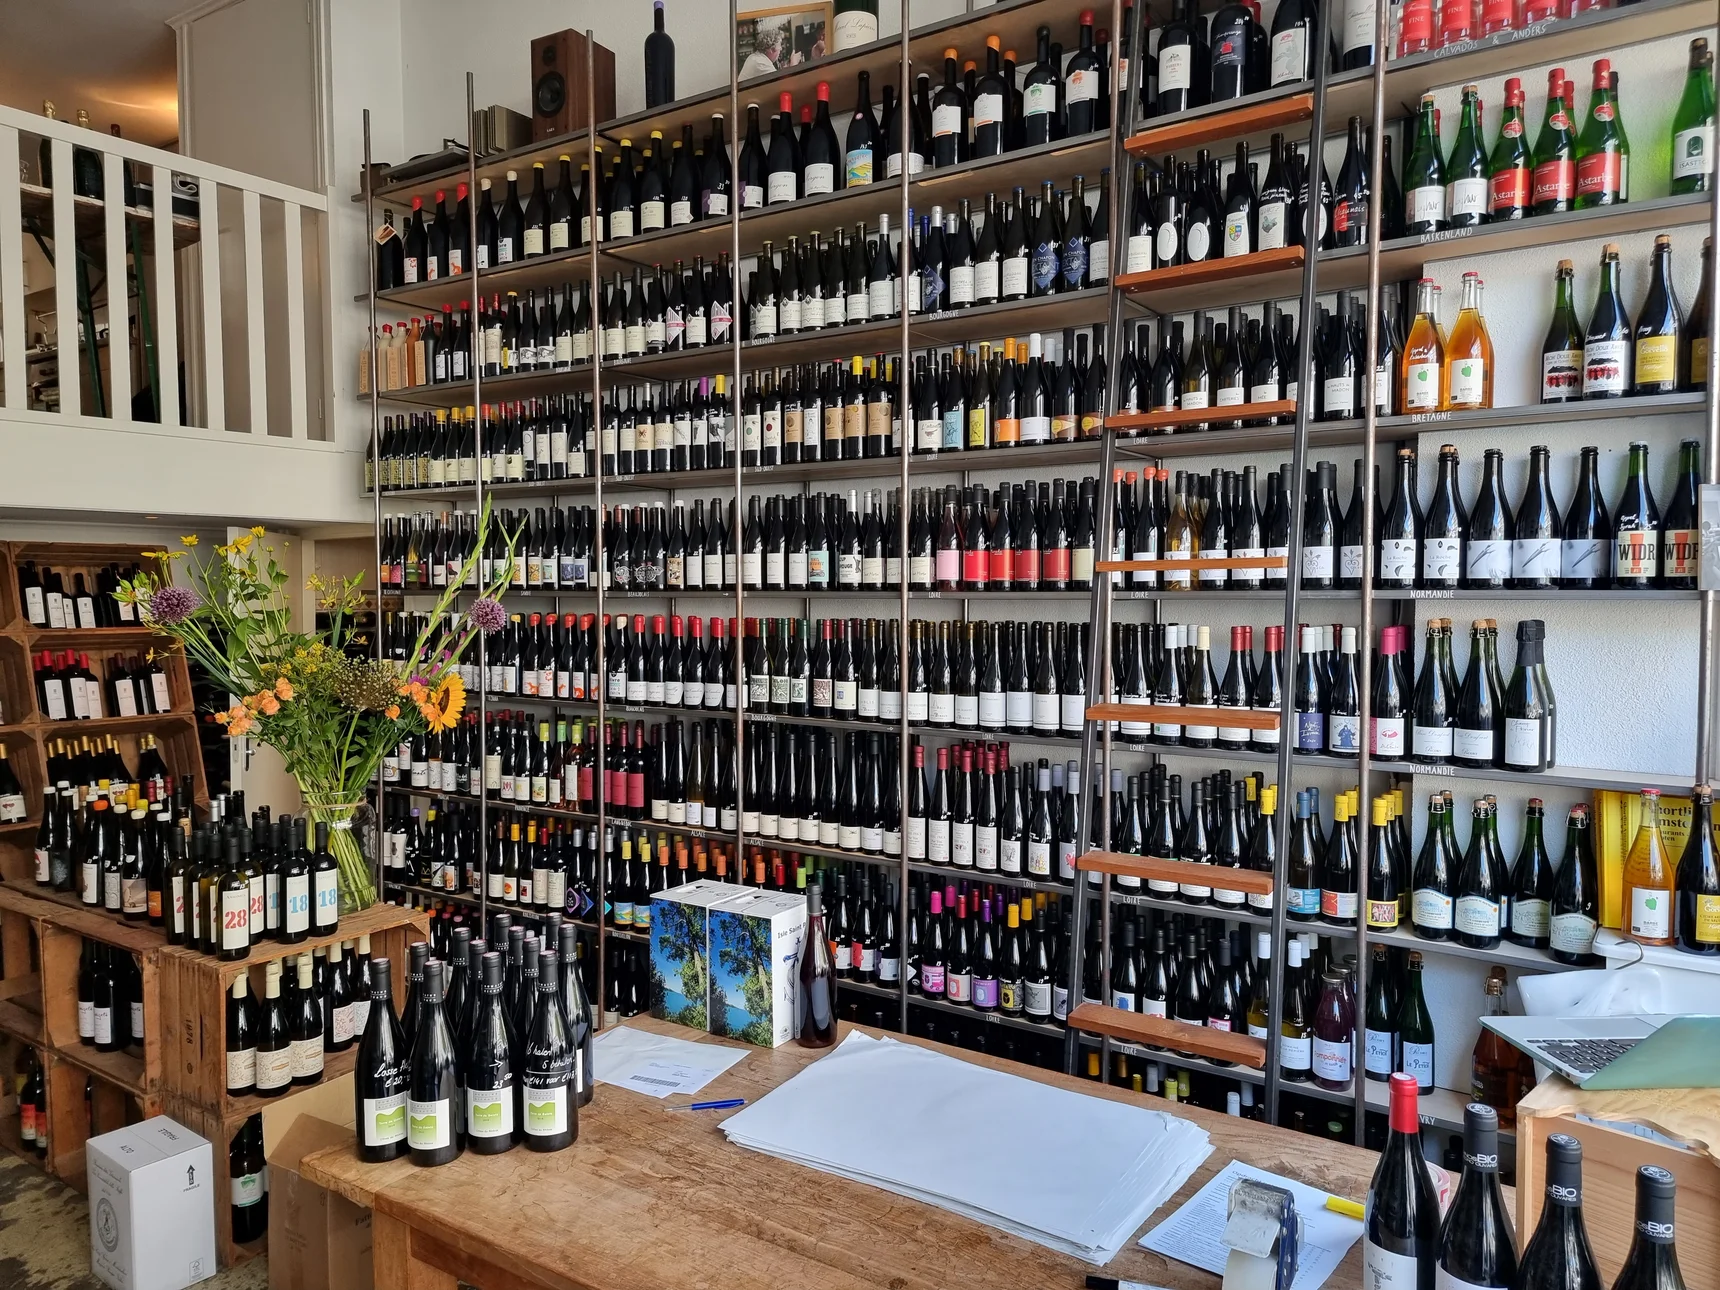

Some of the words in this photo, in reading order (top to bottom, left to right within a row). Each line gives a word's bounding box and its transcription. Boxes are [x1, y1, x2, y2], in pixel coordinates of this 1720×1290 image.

[1409, 16, 1425, 24] FINE
[1434, 41, 1478, 58] CALVADOS
[1492, 35, 1500, 45] &
[1512, 25, 1547, 41] ANDERS
[1420, 227, 1473, 244] BASKENLAND
[929, 310, 960, 321] BOURGOGNE
[1411, 411, 1452, 423] BRETAGNE
[1133, 437, 1148, 445] LOIRE
[1619, 543, 1656, 561] WIDR
[1410, 590, 1454, 598] NORMANDIE
[1410, 765, 1455, 775] NORMANDIE
[690, 830, 706, 838] ALSACE
[1023, 881, 1037, 889] LOIRE
[319, 888, 337, 907] 18
[1123, 896, 1141, 905] LOIRE
[289, 894, 308, 913] 18
[225, 909, 247, 929] 28
[788, 924, 802, 936] Saint
[985, 1015, 1001, 1024] LOIRE
[1121, 1045, 1138, 1055] LOIRE
[1553, 1184, 1577, 1198] BIO
[1647, 1221, 1674, 1234] BIO
